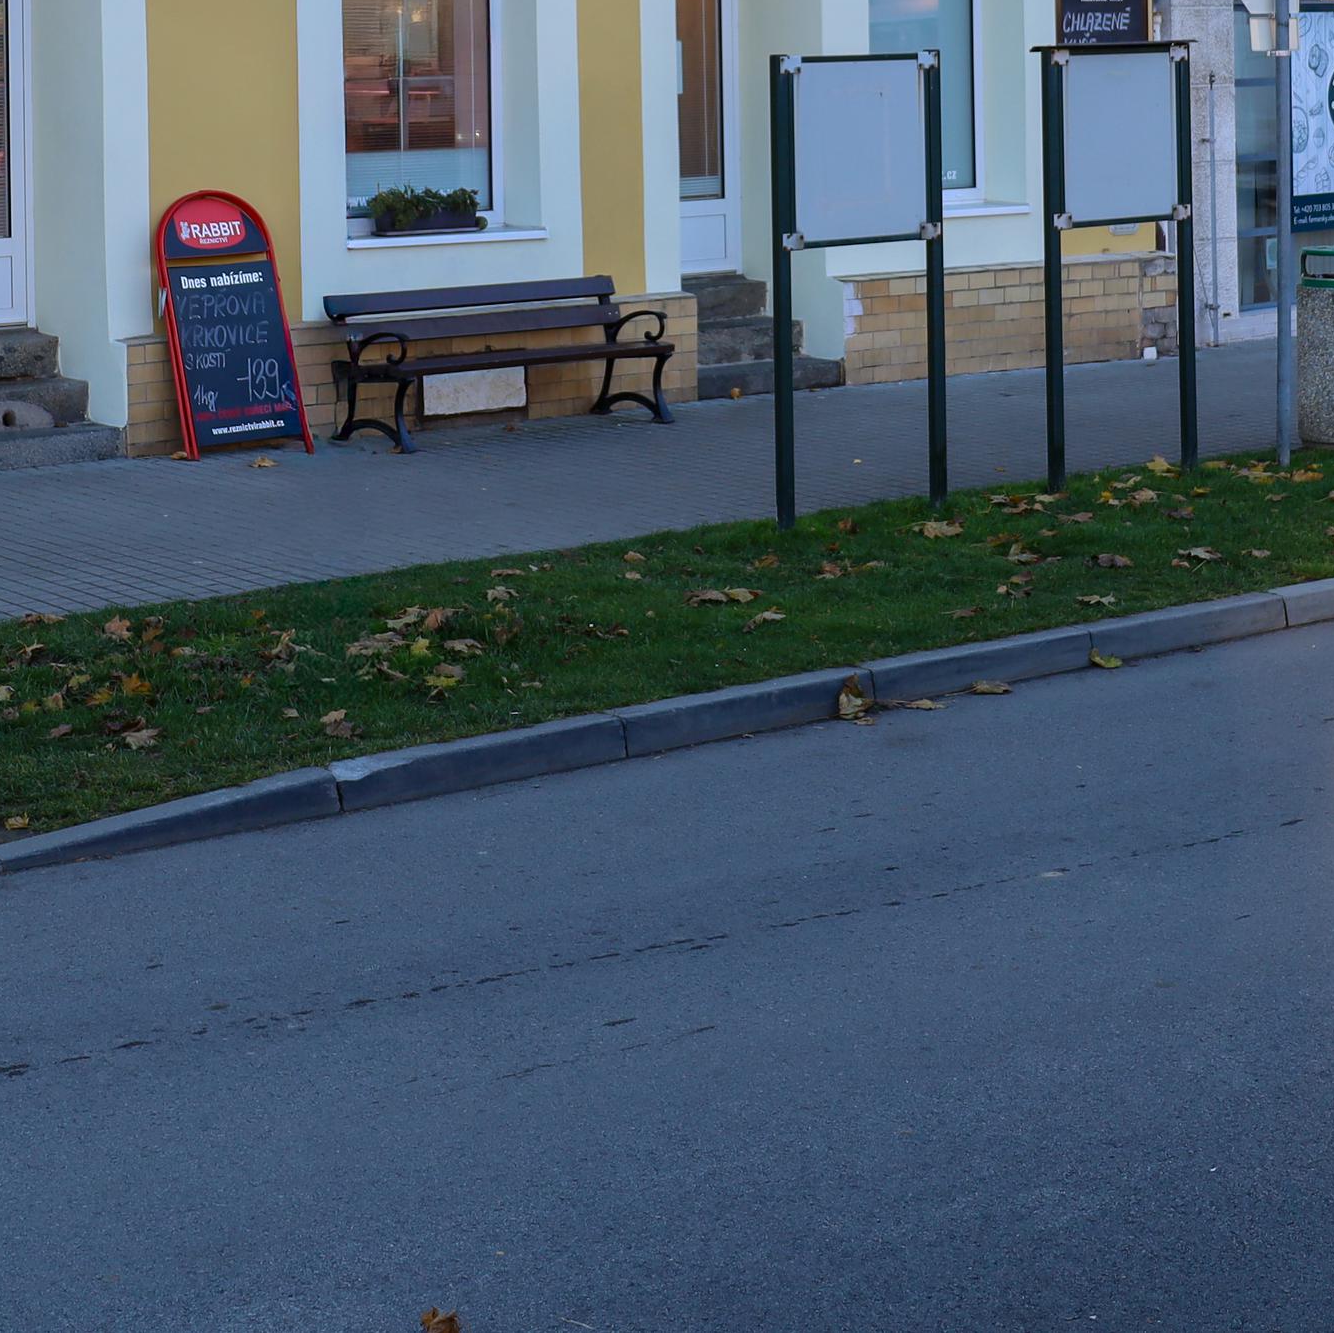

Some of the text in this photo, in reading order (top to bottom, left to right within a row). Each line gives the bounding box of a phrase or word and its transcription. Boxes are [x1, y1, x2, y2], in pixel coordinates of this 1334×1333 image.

[1063, 7, 1131, 33] CHLAZENÉ
[190, 221, 241, 238] RABBIT
[180, 271, 264, 289] Dnes nabízíme:
[180, 320, 269, 348] KRKOVICE
